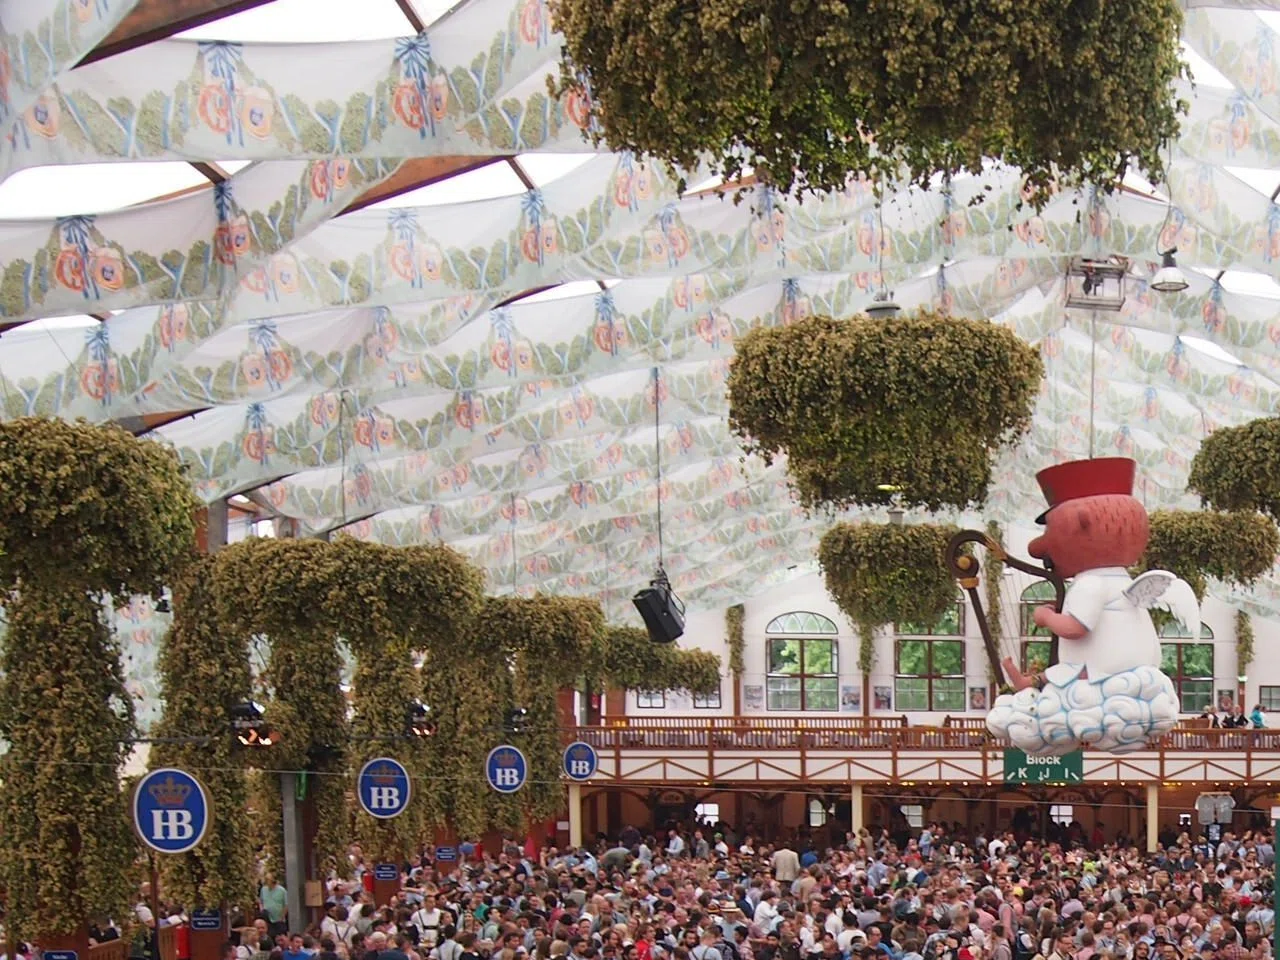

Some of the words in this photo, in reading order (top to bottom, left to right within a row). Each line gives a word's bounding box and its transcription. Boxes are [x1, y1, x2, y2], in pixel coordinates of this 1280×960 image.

[570, 760, 590, 775] HB
[1018, 767, 1028, 778] K
[1043, 767, 1050, 778] J
[495, 768, 519, 786] HB
[370, 786, 400, 809] HB
[150, 809, 194, 840] HB
